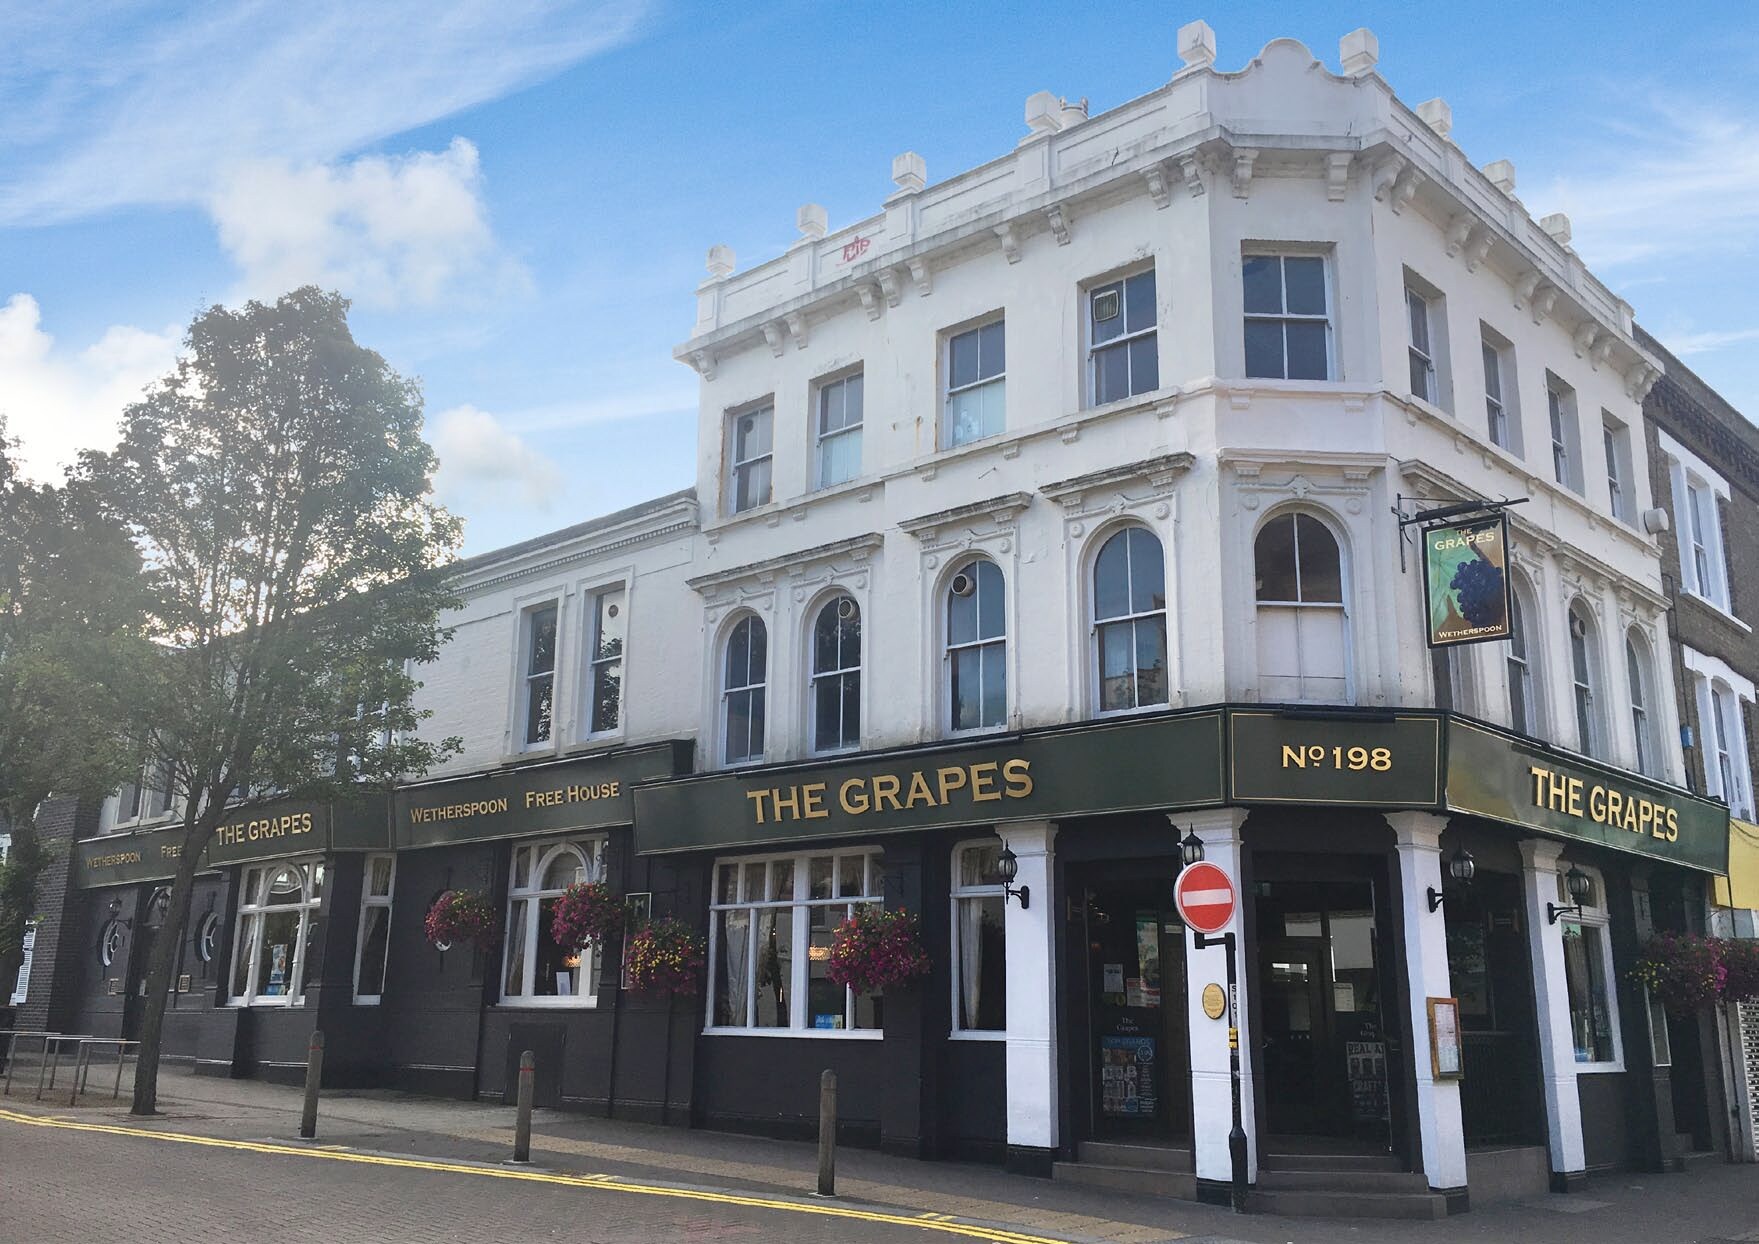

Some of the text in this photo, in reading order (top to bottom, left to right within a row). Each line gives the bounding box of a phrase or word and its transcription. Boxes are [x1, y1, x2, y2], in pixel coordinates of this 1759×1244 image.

[1434, 531, 1495, 551] GRAPES
[1456, 528, 1473, 537] THE
[1439, 624, 1503, 639] WETHERSPOON
[1332, 746, 1392, 771] 198
[410, 782, 620, 824] WETHERSPOON FREE HOUSE
[746, 758, 1034, 824] THE GRAPES
[1531, 766, 1679, 842] THE GRAPES
[216, 813, 312, 846] THE GRAPES
[85, 851, 141, 869] WETHERSPOON
